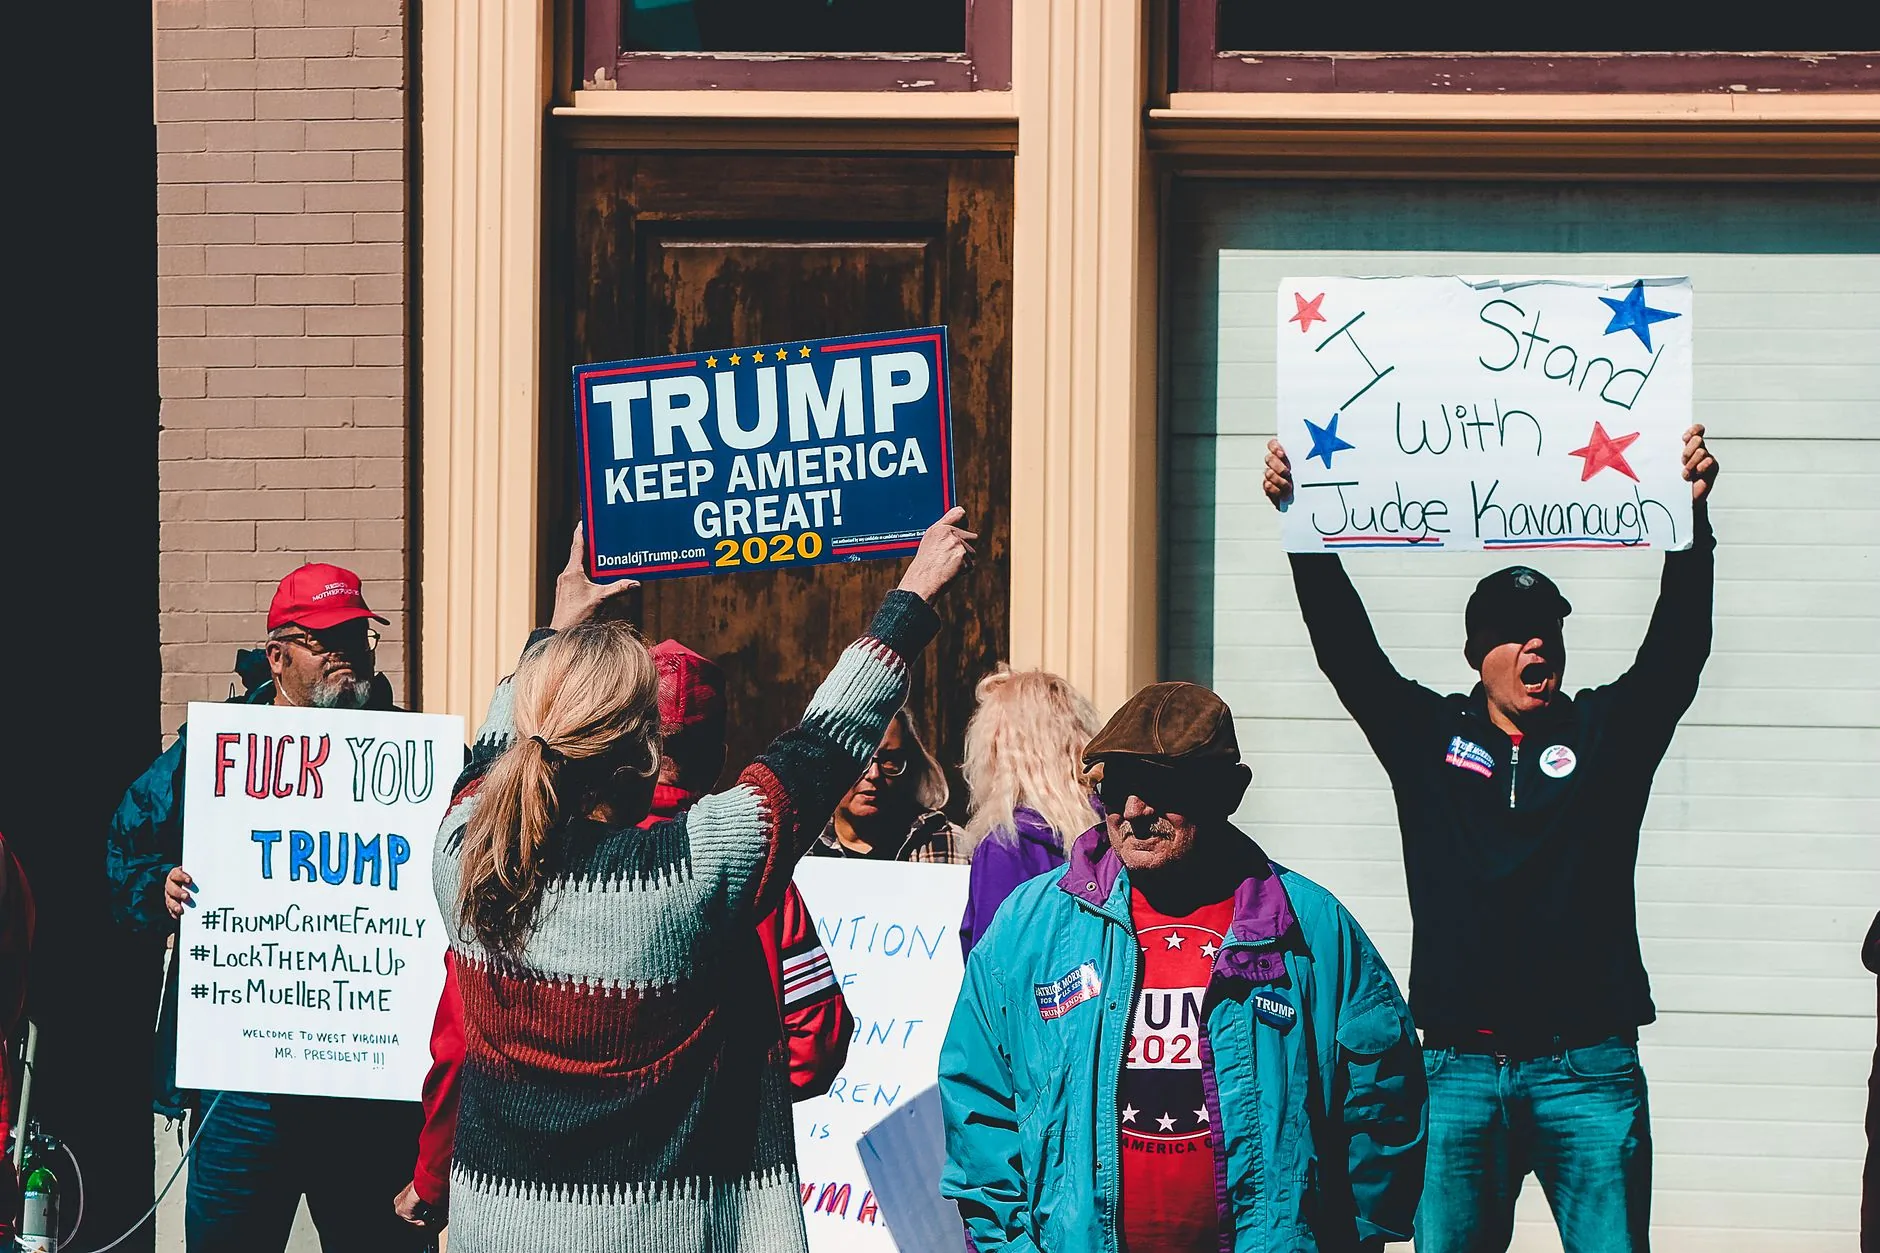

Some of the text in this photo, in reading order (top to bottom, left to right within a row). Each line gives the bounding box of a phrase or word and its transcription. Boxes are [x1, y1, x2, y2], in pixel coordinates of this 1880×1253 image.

[1315, 299, 1665, 411] I Stand
[592, 351, 930, 460] TRUMP
[1396, 398, 1542, 456] With
[604, 437, 929, 505] KEEP AMERICA
[692, 488, 843, 539] GREAT!
[1301, 480, 1677, 546] Judge Kavanaugh
[597, 547, 706, 567] DonaldjTrump.com
[714, 531, 823, 567] 2020
[214, 732, 434, 804] FUCK YOU
[250, 830, 411, 891] TRUMP
[818, 915, 945, 960] NTION
[841, 973, 858, 992] F
[1255, 995, 1295, 1018] TRUMP
[242, 1028, 400, 1046] WELCOME TO WEST VIRGINIA
[853, 1016, 923, 1049] ANT
[1127, 1033, 1201, 1063] 202
[274, 1047, 297, 1059] MR.
[304, 1048, 369, 1063] PRESIDENT
[828, 1077, 901, 1107] REN
[809, 1123, 830, 1139] IS
